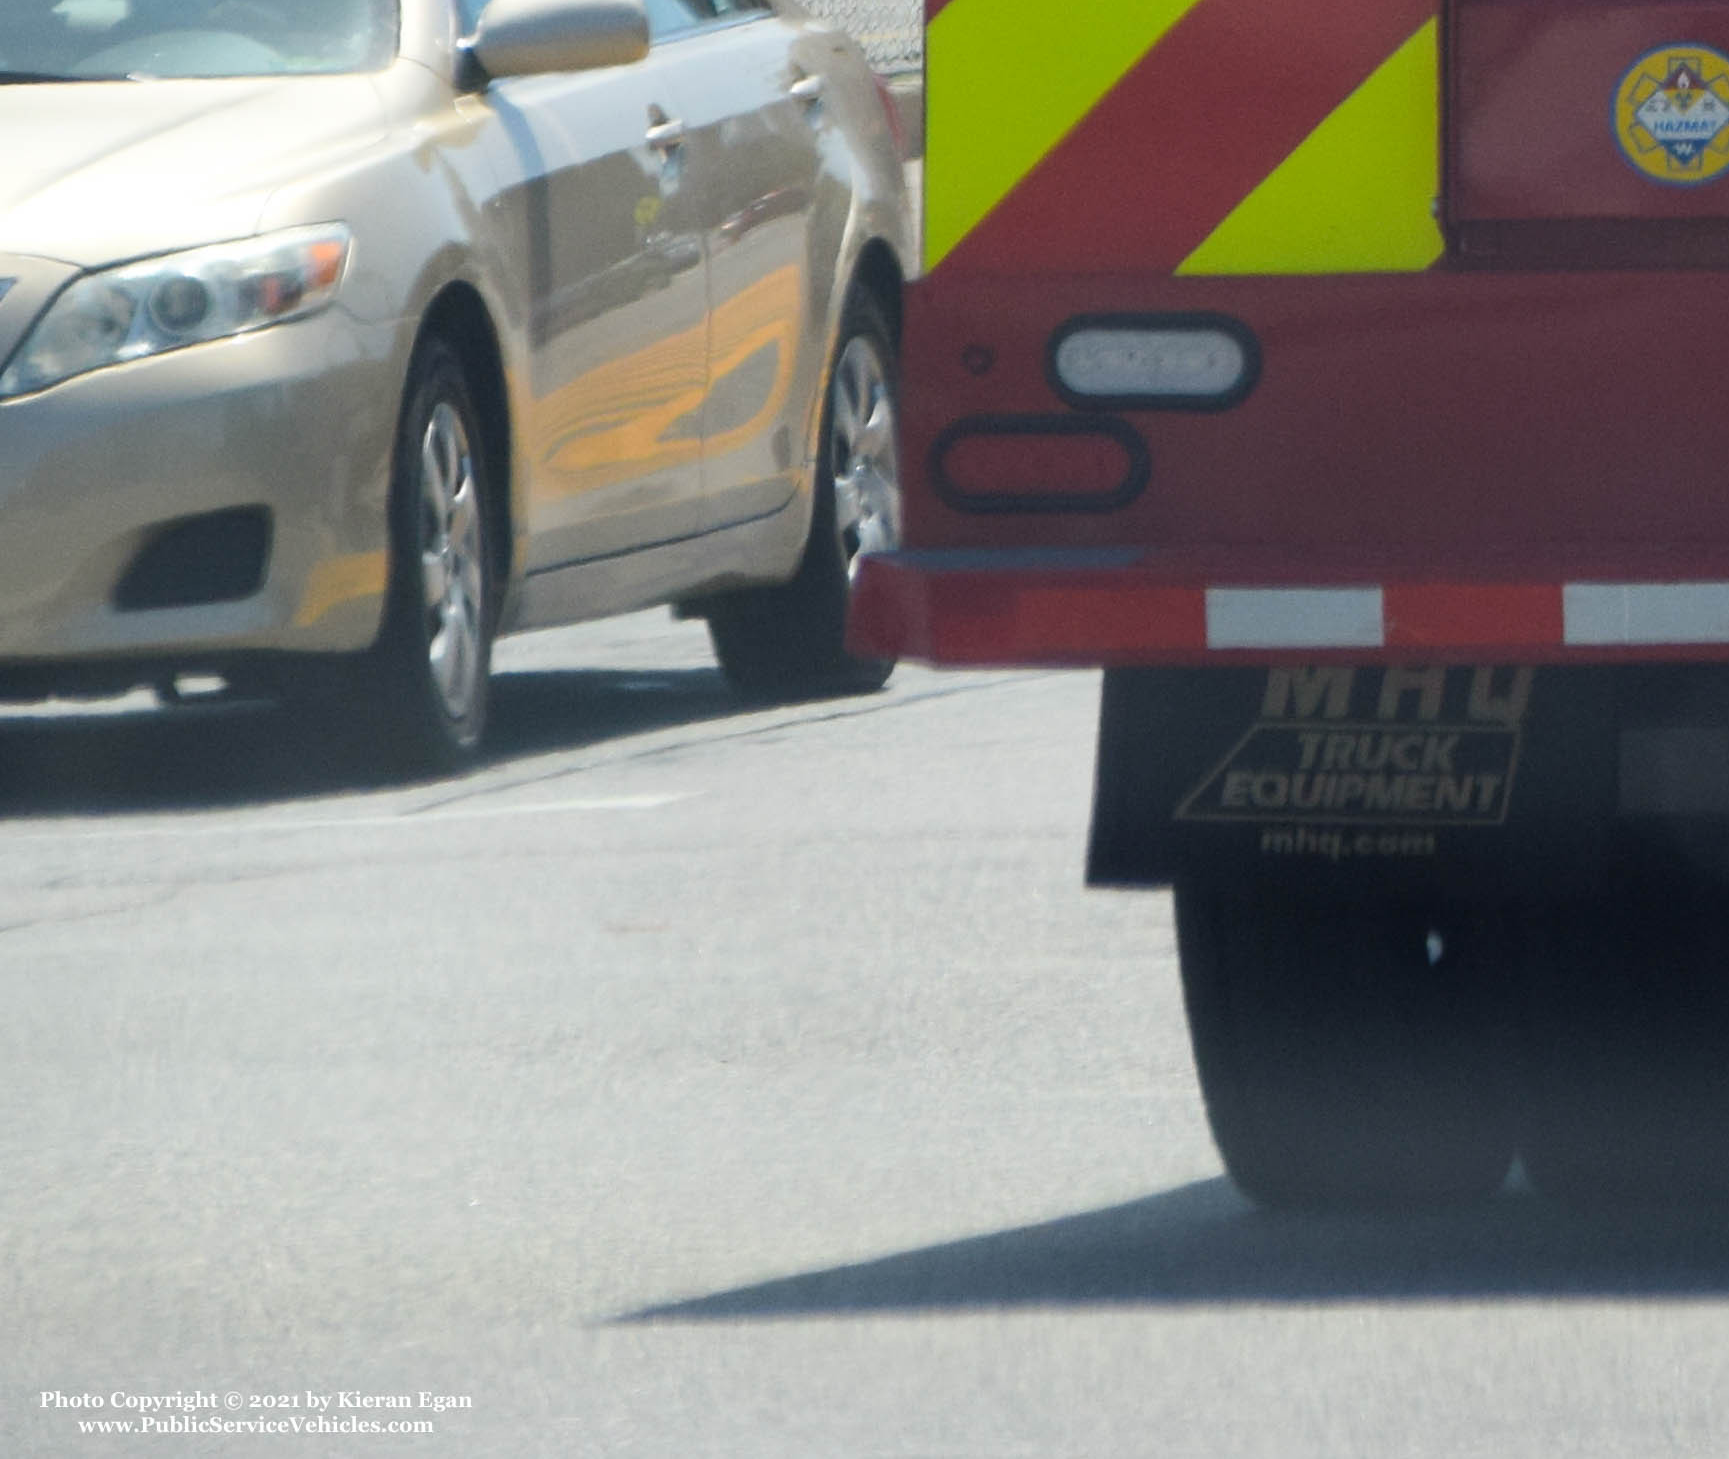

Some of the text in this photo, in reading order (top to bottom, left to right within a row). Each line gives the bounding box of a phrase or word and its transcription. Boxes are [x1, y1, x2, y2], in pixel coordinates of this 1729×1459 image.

[1298, 733, 1461, 771] TRUCK
[1220, 771, 1501, 812] EQUIPMENT
[1260, 828, 1436, 861] mhq.com
